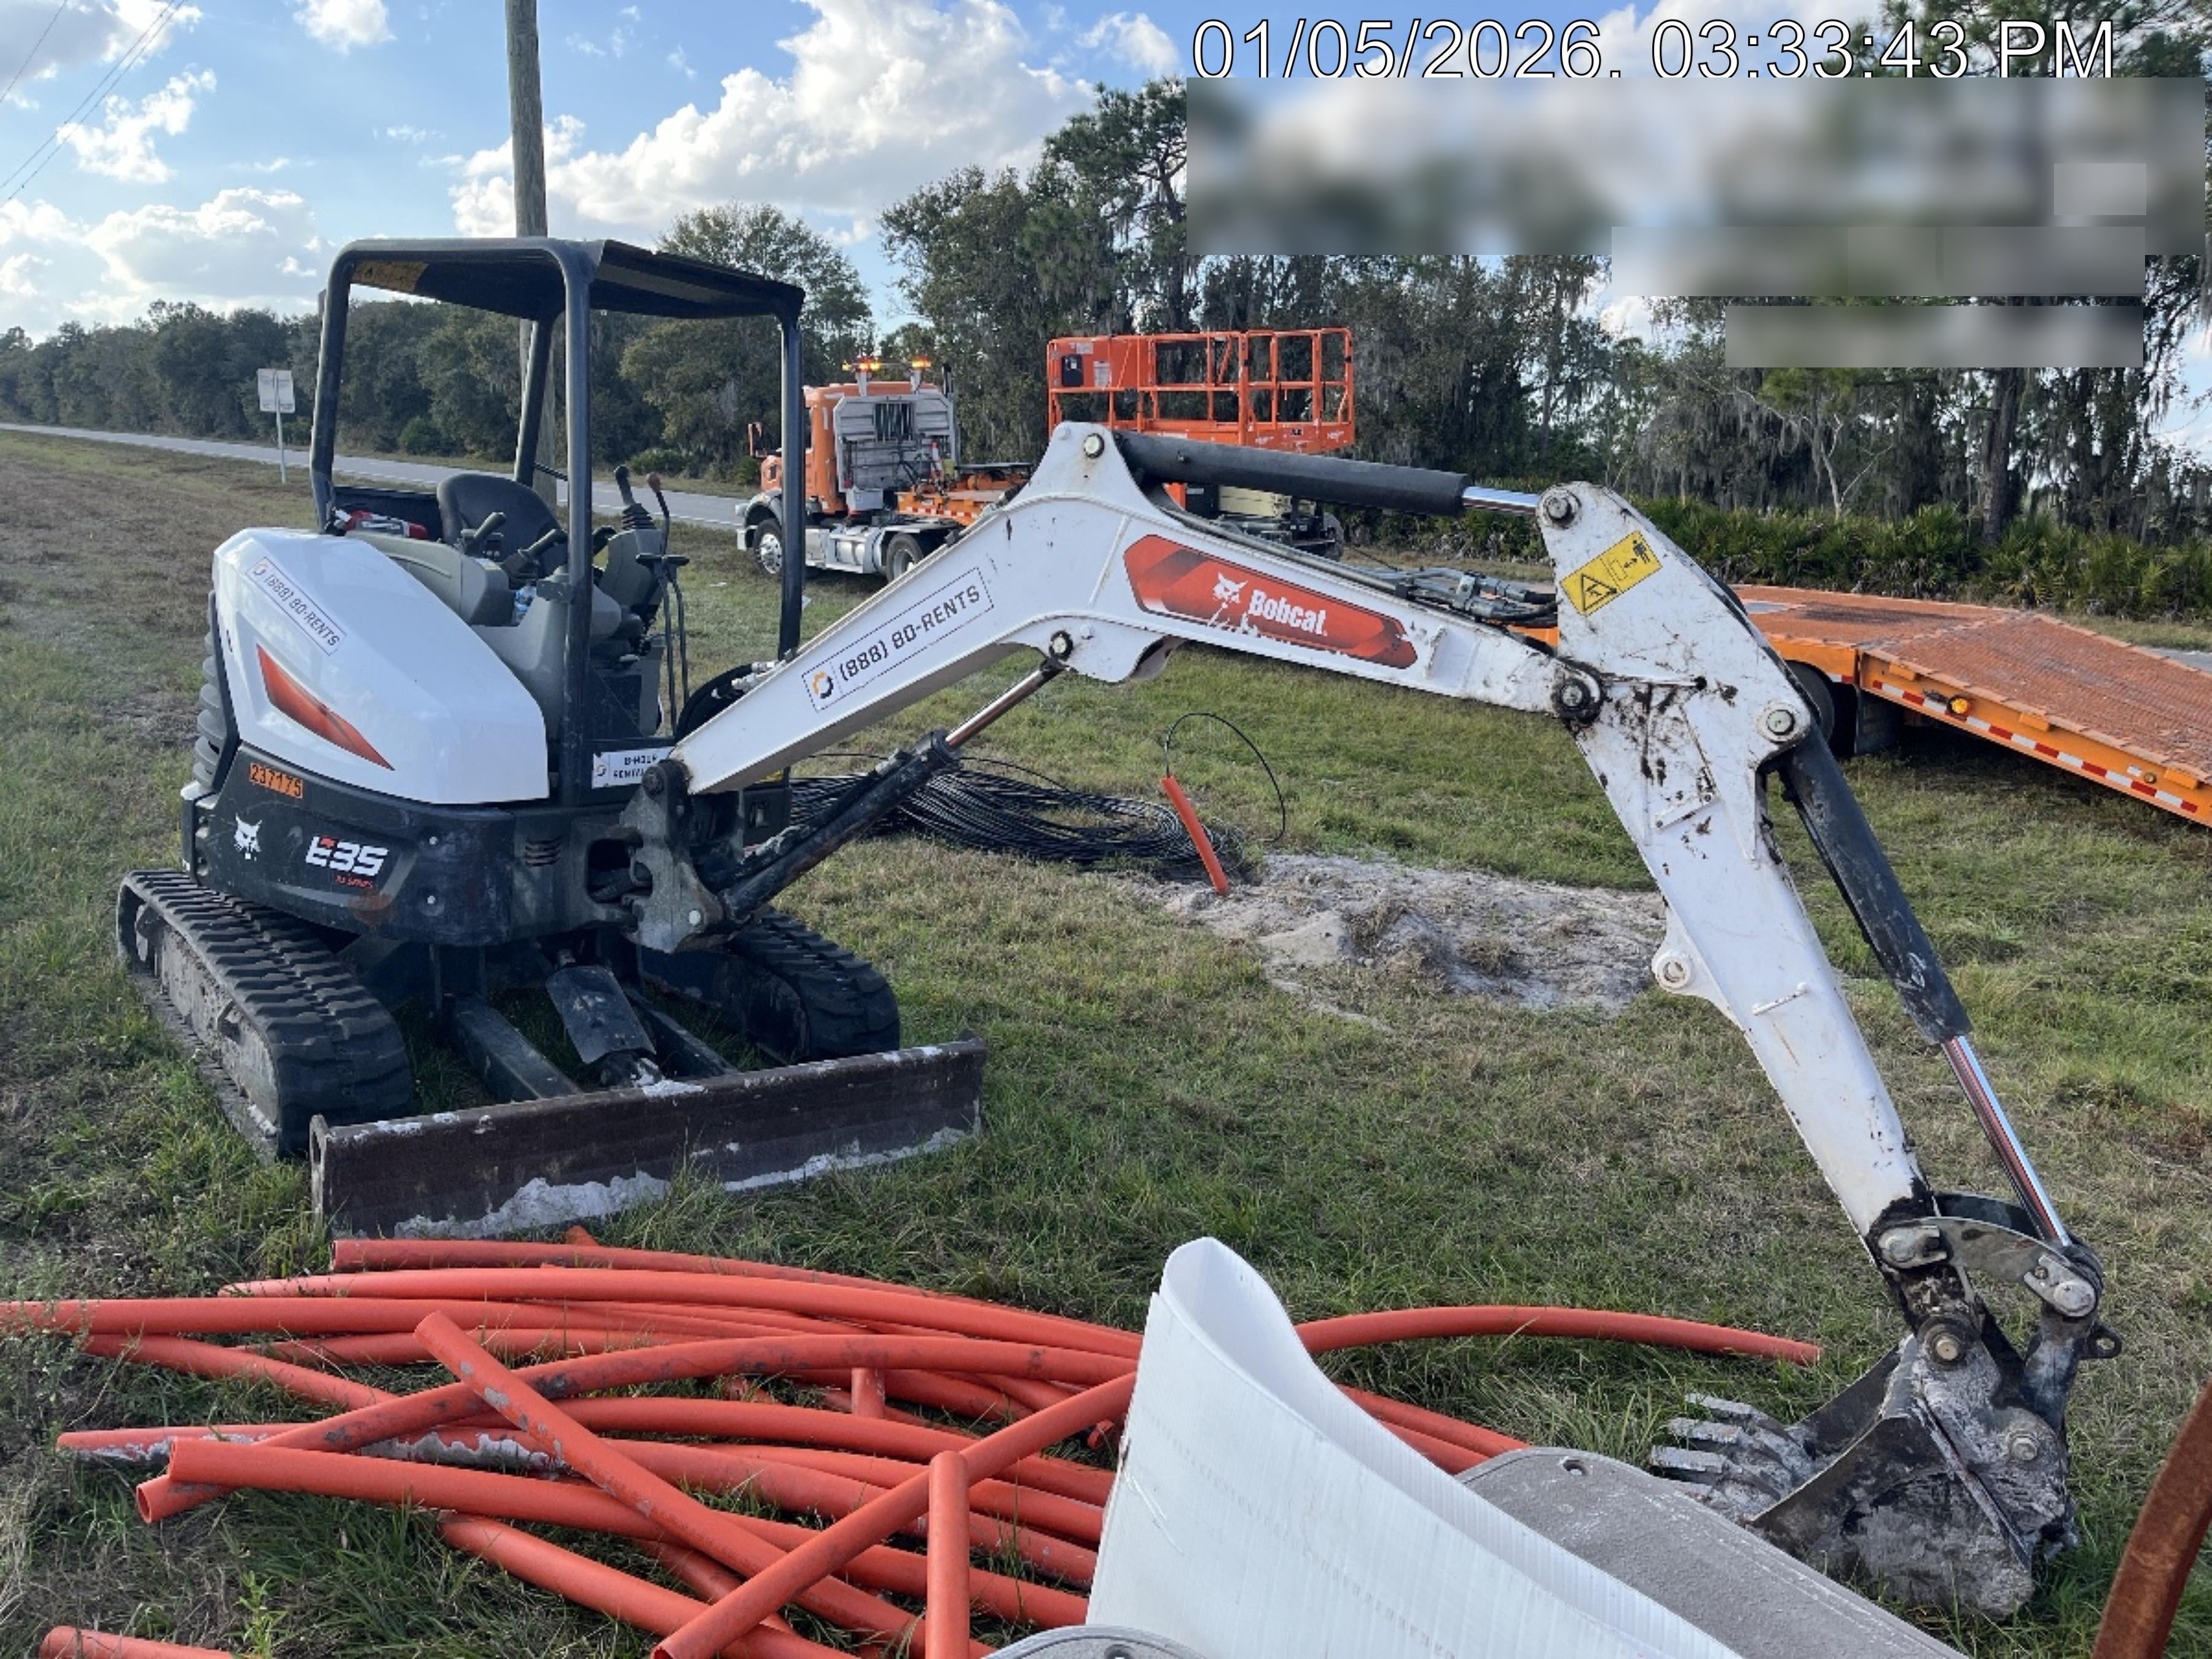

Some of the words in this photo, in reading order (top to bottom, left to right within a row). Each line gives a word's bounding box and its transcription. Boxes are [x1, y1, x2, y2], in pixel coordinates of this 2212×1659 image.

[839, 640, 888, 681] (888)
[892, 585, 980, 649] 80-RENTS
[1248, 589, 1325, 637] Bobcat
[251, 764, 301, 797] 237175
[305, 836, 390, 877] E35
